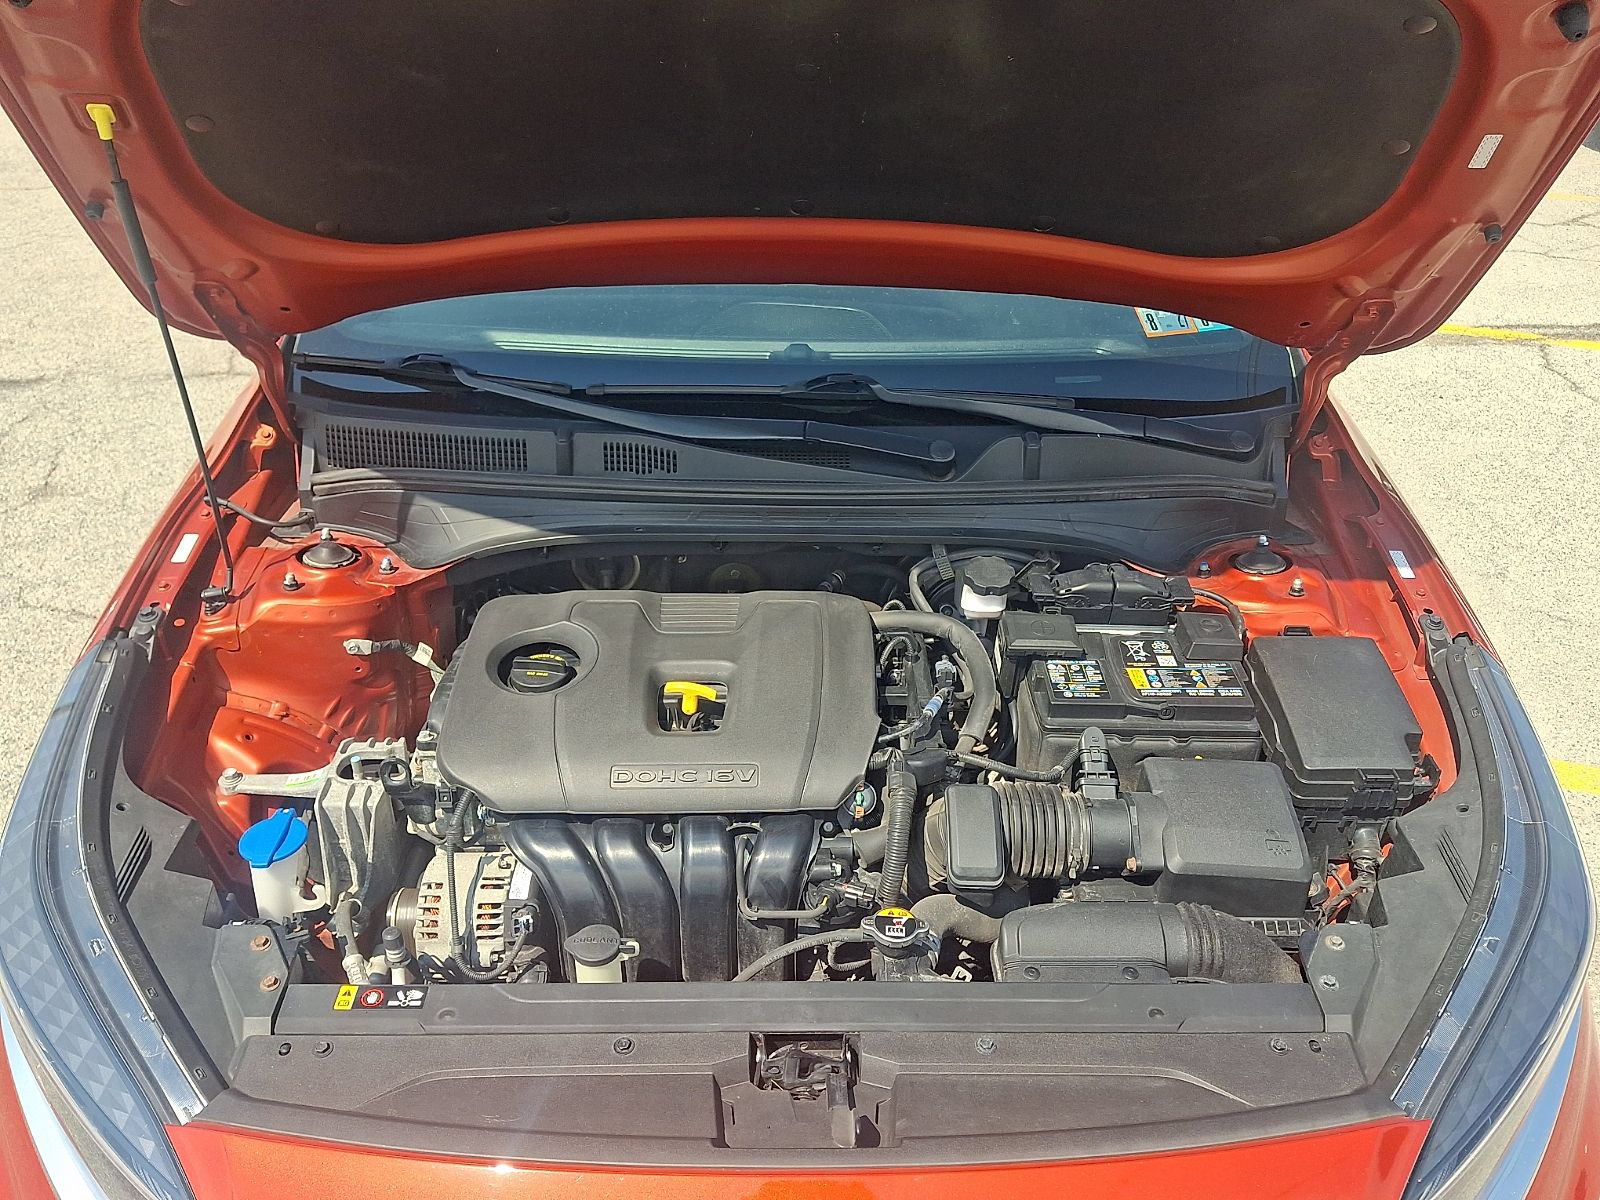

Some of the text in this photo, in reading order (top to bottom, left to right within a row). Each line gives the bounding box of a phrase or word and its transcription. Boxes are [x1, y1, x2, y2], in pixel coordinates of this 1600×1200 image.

[1145, 313, 1158, 331] 8
[612, 769, 756, 783] DOHC 16V
[573, 936, 619, 945] COOLANT
